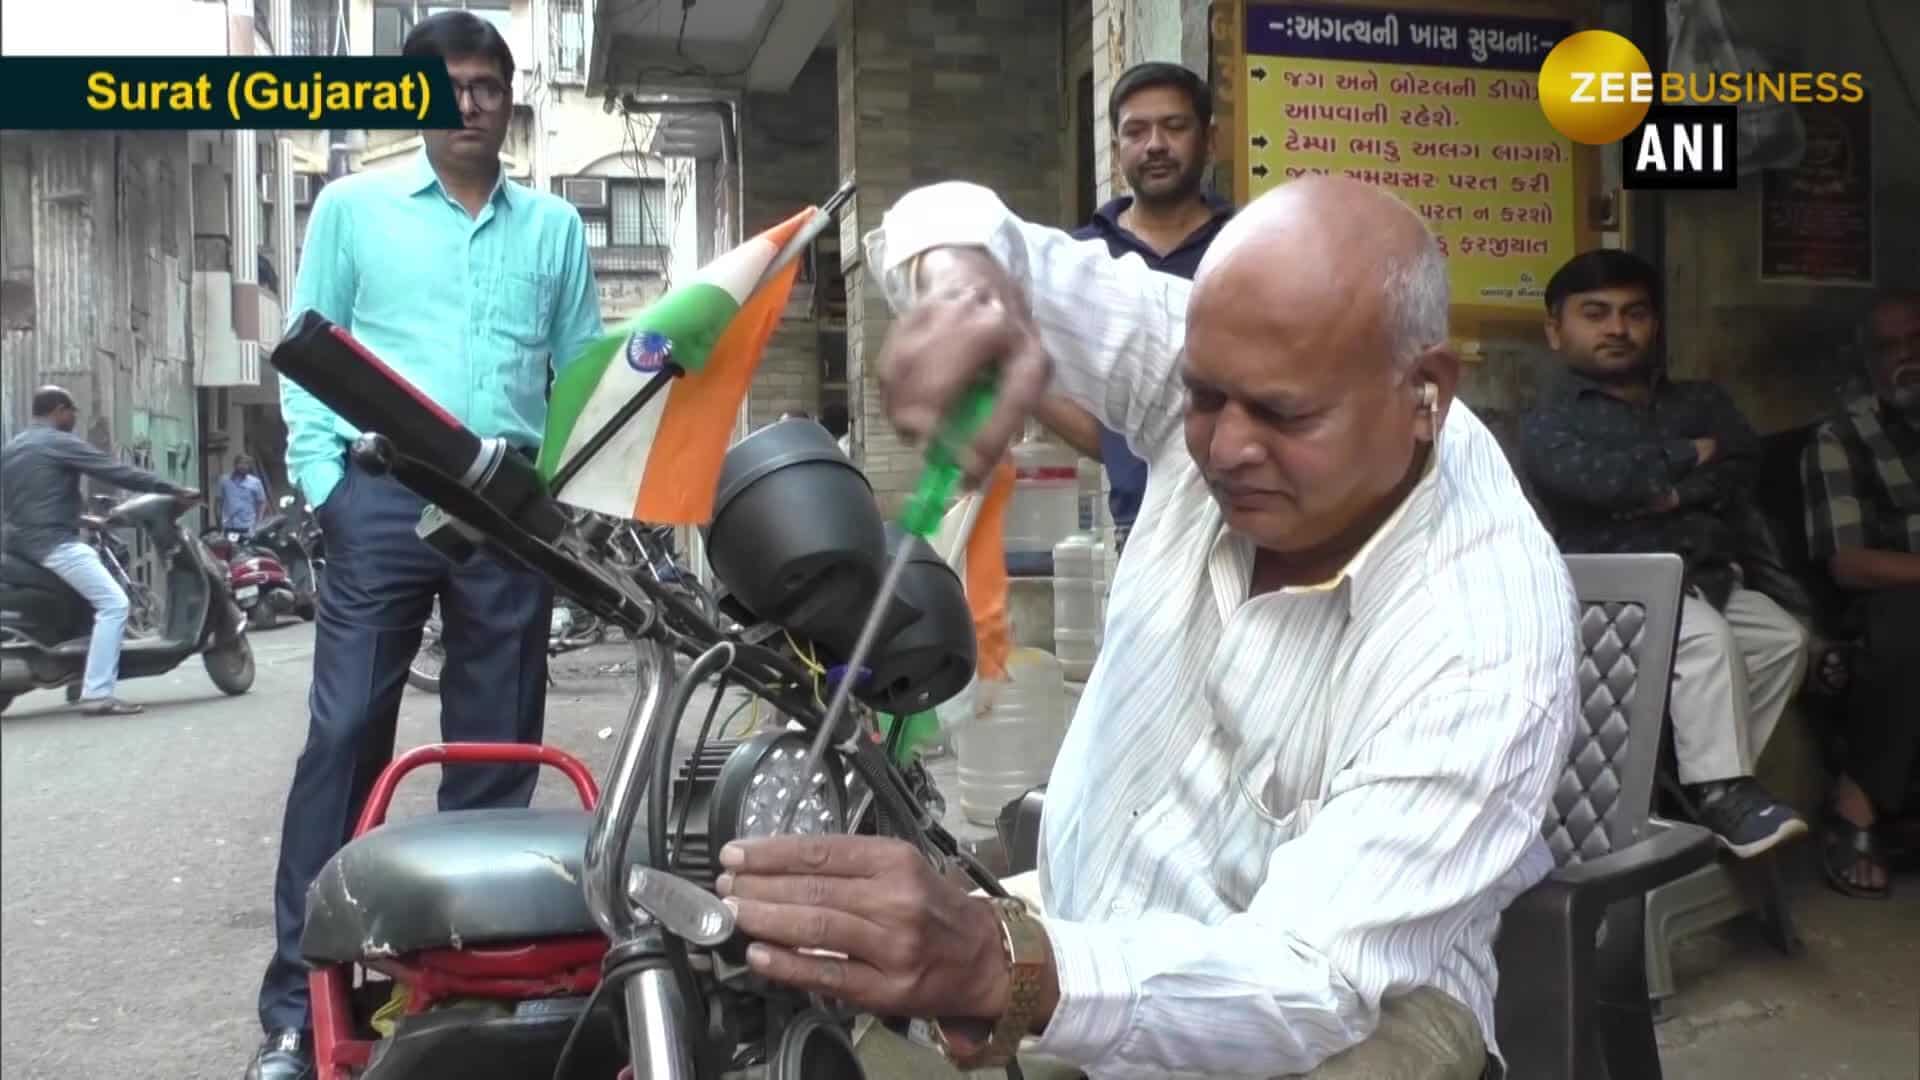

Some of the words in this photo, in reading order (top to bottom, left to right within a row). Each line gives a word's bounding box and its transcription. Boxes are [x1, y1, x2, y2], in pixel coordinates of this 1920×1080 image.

[1409, 22, 1457, 50] ખાસ
[1284, 70, 1325, 90] જગ
[1335, 69, 1379, 92] અને
[1284, 103, 1388, 125] આપવાની
[1284, 128, 1336, 154] ટેમ્પા
[1412, 140, 1480, 160] અલગ
[1447, 172, 1498, 192] પરત
[1510, 172, 1550, 194] કરી
[1419, 203, 1463, 221] પરત
[1472, 205, 1490, 222] ન
[1501, 202, 1553, 225] કરશો
